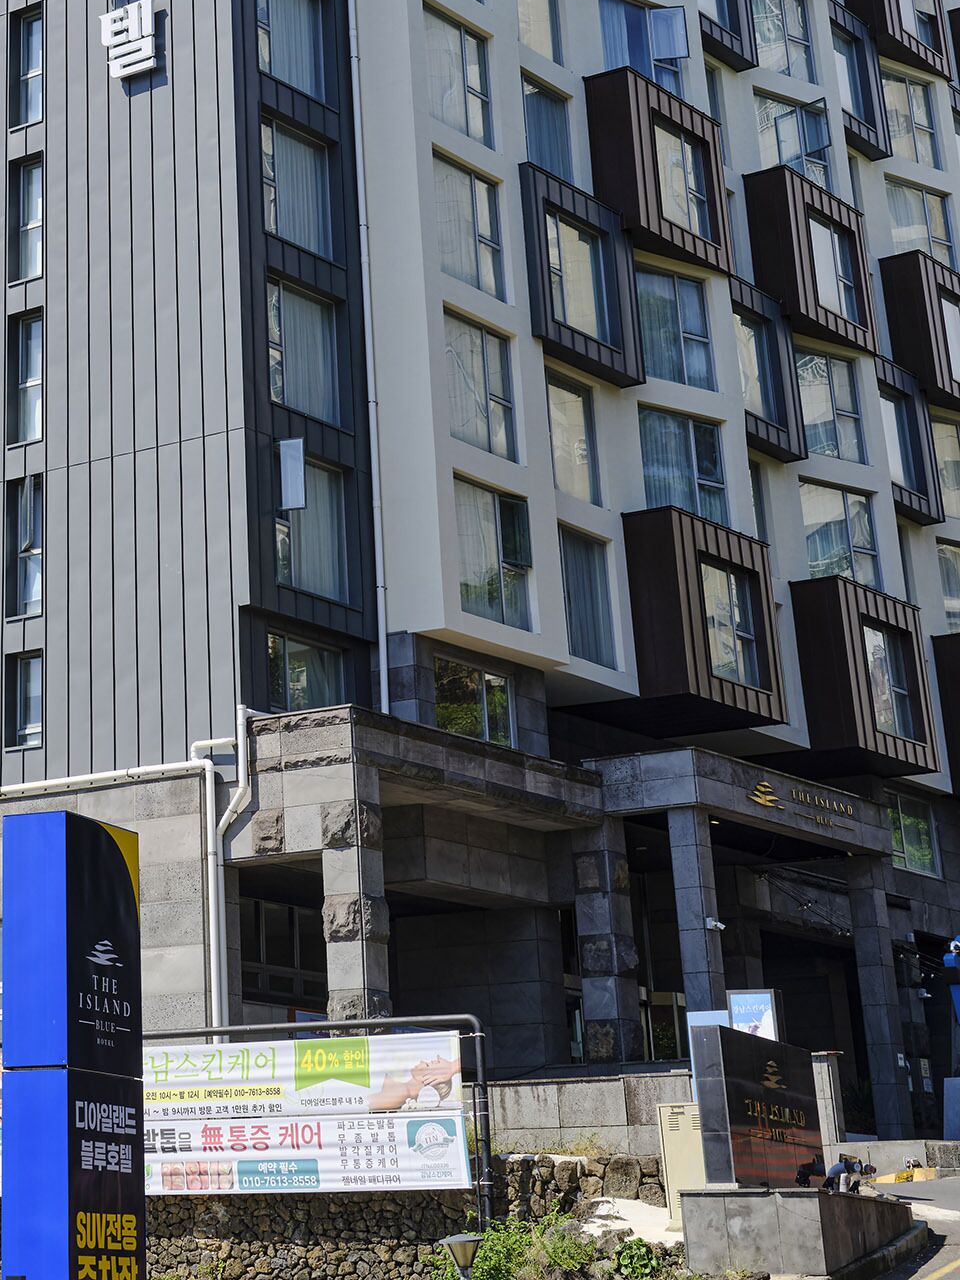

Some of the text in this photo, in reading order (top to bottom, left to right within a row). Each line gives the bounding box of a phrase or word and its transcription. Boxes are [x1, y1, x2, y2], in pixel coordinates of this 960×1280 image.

[815, 796, 853, 816] ISLAND
[92, 974, 118, 995] THE
[79, 992, 131, 1017] ISLAND
[95, 1019, 116, 1033] BLUE
[96, 1037, 115, 1048] HOTEL
[144, 1047, 276, 1083] 남스킨케어
[301, 1049, 365, 1072] 40% 할인
[145, 1091, 157, 1101] 오전
[188, 1090, 200, 1099] 12시
[234, 1087, 281, 1098] 010-7613-8558
[353, 1096, 364, 1105] 1층
[75, 1100, 137, 1135] 디아일랜드
[171, 1106, 197, 1116] 9시까지
[199, 1105, 213, 1115] 방문
[215, 1105, 229, 1114] 고객
[232, 1104, 249, 1113] 1만원
[251, 1104, 265, 1113] 추가
[279, 1121, 323, 1150] 케어
[80, 1139, 132, 1174] 블루호텔
[258, 1161, 298, 1174] 예약 필수
[243, 1175, 317, 1187] 010-7613-8558
[76, 1211, 137, 1251] SUV전용
